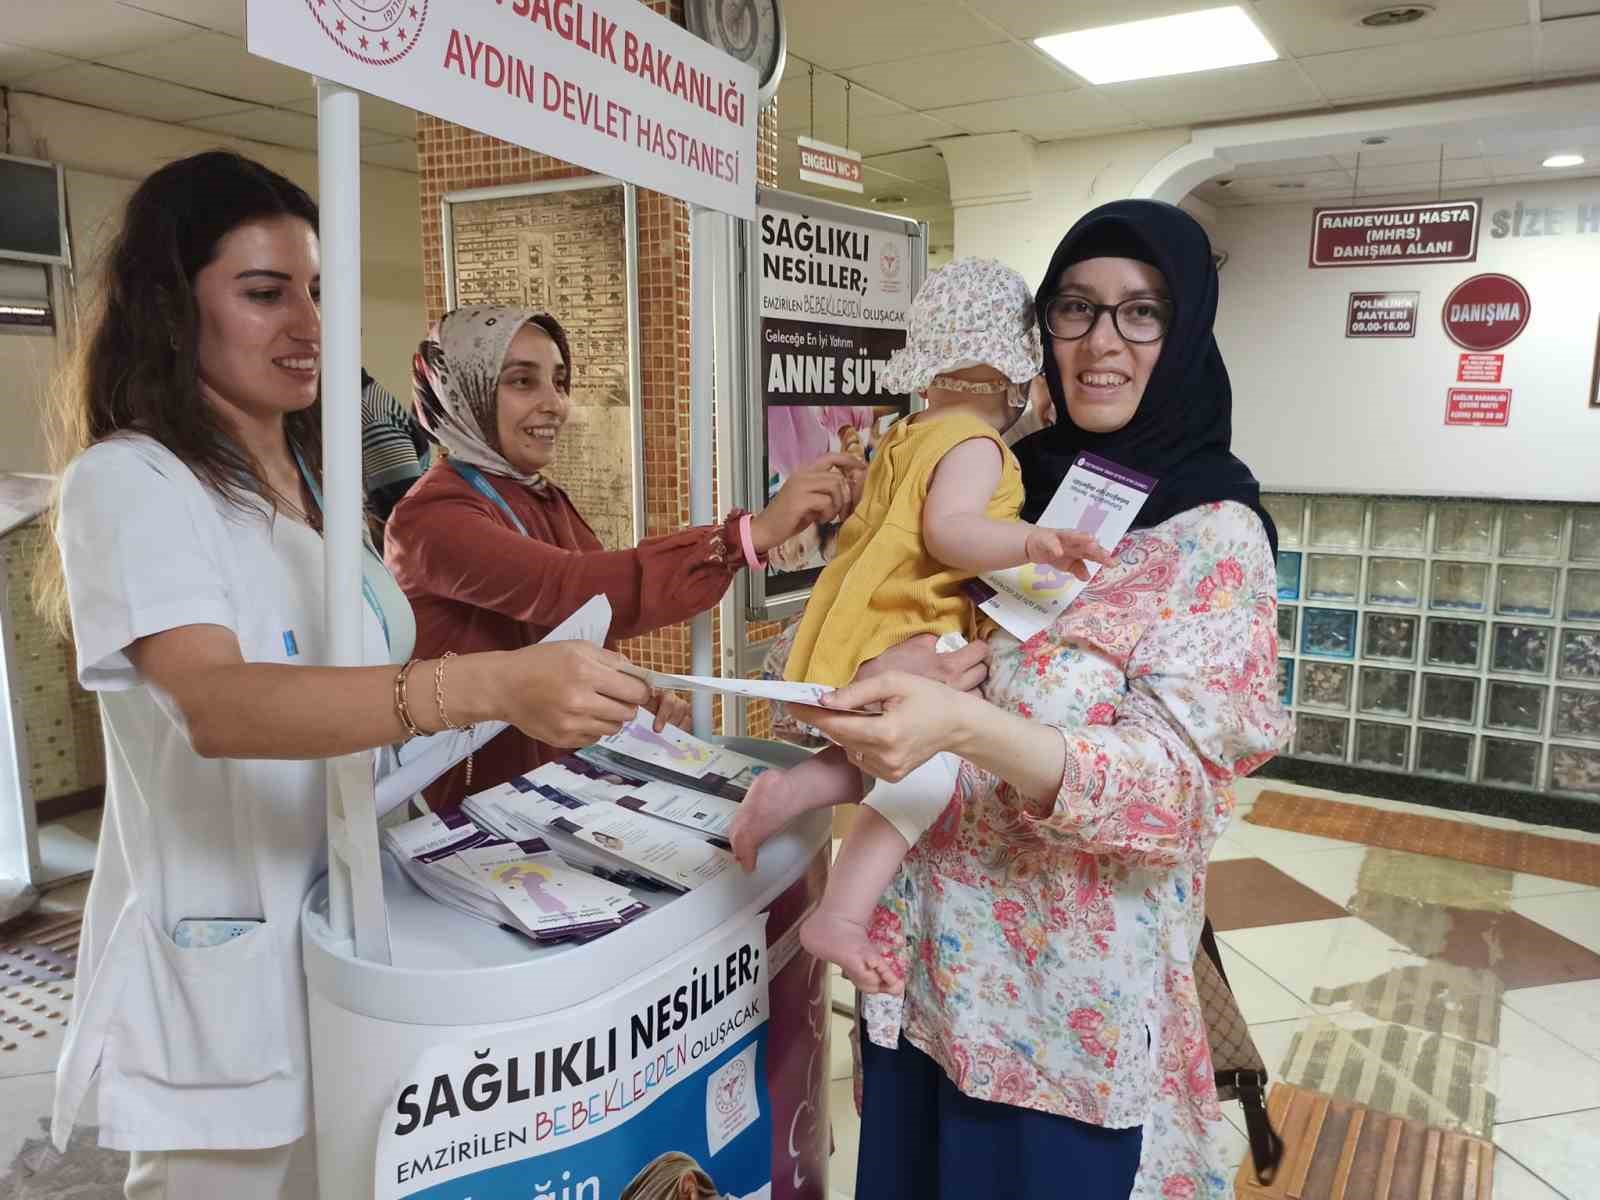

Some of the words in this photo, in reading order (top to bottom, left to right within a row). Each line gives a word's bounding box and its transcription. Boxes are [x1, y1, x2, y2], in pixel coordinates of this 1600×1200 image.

[624, 30, 744, 127] BAKANLIĞI
[444, 29, 534, 103] AYDIN
[543, 72, 631, 143] DEVLET
[637, 114, 739, 184] HASTANESİ
[1322, 213, 1414, 228] RANDEVULU
[1419, 209, 1470, 223] HASTA
[1366, 227, 1421, 243] (MHRS)
[761, 214, 869, 262] SAĞLIKLI
[1333, 244, 1402, 259] DANIŞMA
[1406, 241, 1452, 255] ALANI
[763, 253, 868, 296] NESİLLER;
[763, 296, 802, 313] EMZİRİLEN
[863, 308, 905, 322] OLUŞACAK
[1357, 310, 1407, 320] SAATLERİ
[1450, 303, 1520, 326] DANIŞMA
[765, 329, 804, 347] Geleceğe
[808, 334, 817, 346] En
[819, 331, 828, 350] İyi
[830, 335, 854, 349] Yatırım
[768, 353, 835, 394] ANNE
[394, 1027, 616, 1136] SAĞLIKLI
[630, 943, 760, 1059] NESİLLER;
[397, 1126, 527, 1184] EMZİRİLEN
[535, 1032, 687, 1141] BEBEKLERDEN
[691, 999, 760, 1060] OLUŞACAK
